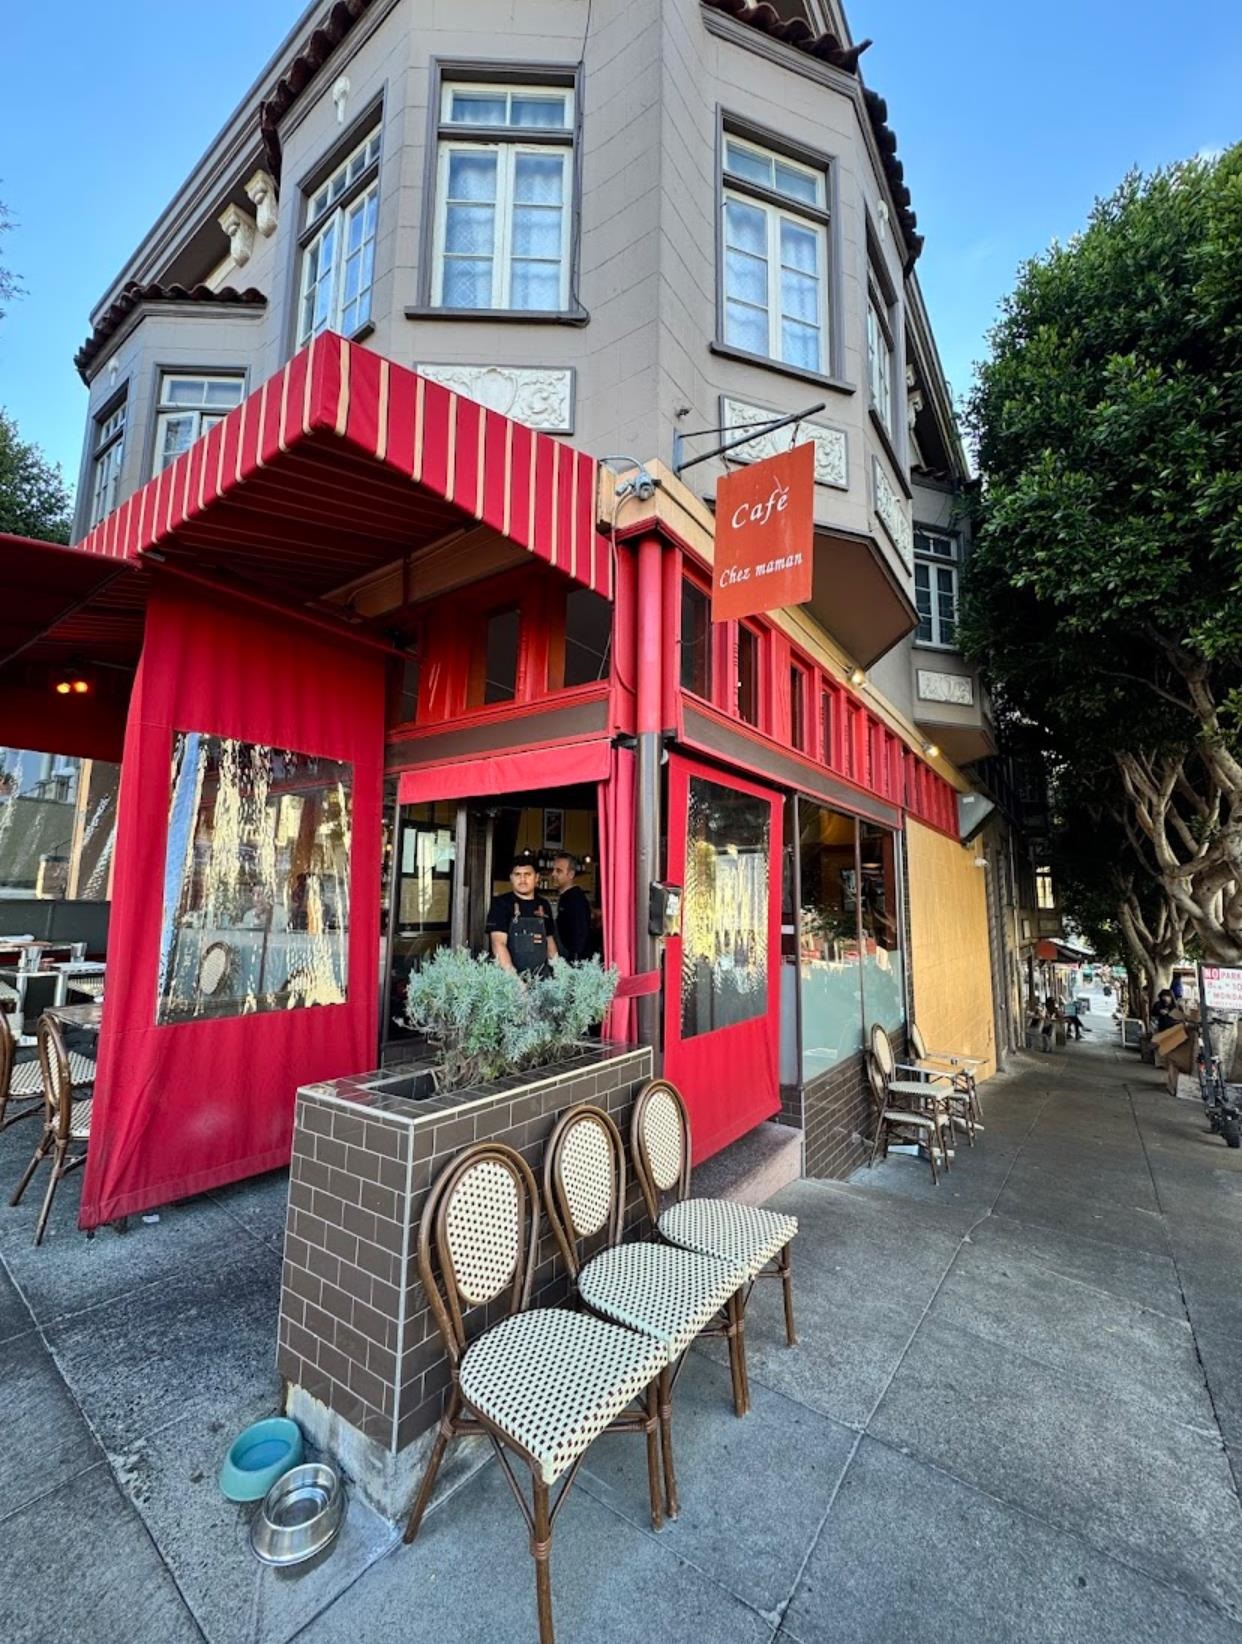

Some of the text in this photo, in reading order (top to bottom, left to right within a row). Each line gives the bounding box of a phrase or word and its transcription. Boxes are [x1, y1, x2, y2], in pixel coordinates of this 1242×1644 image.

[731, 484, 790, 529] Café
[719, 552, 803, 588] Chez maman
